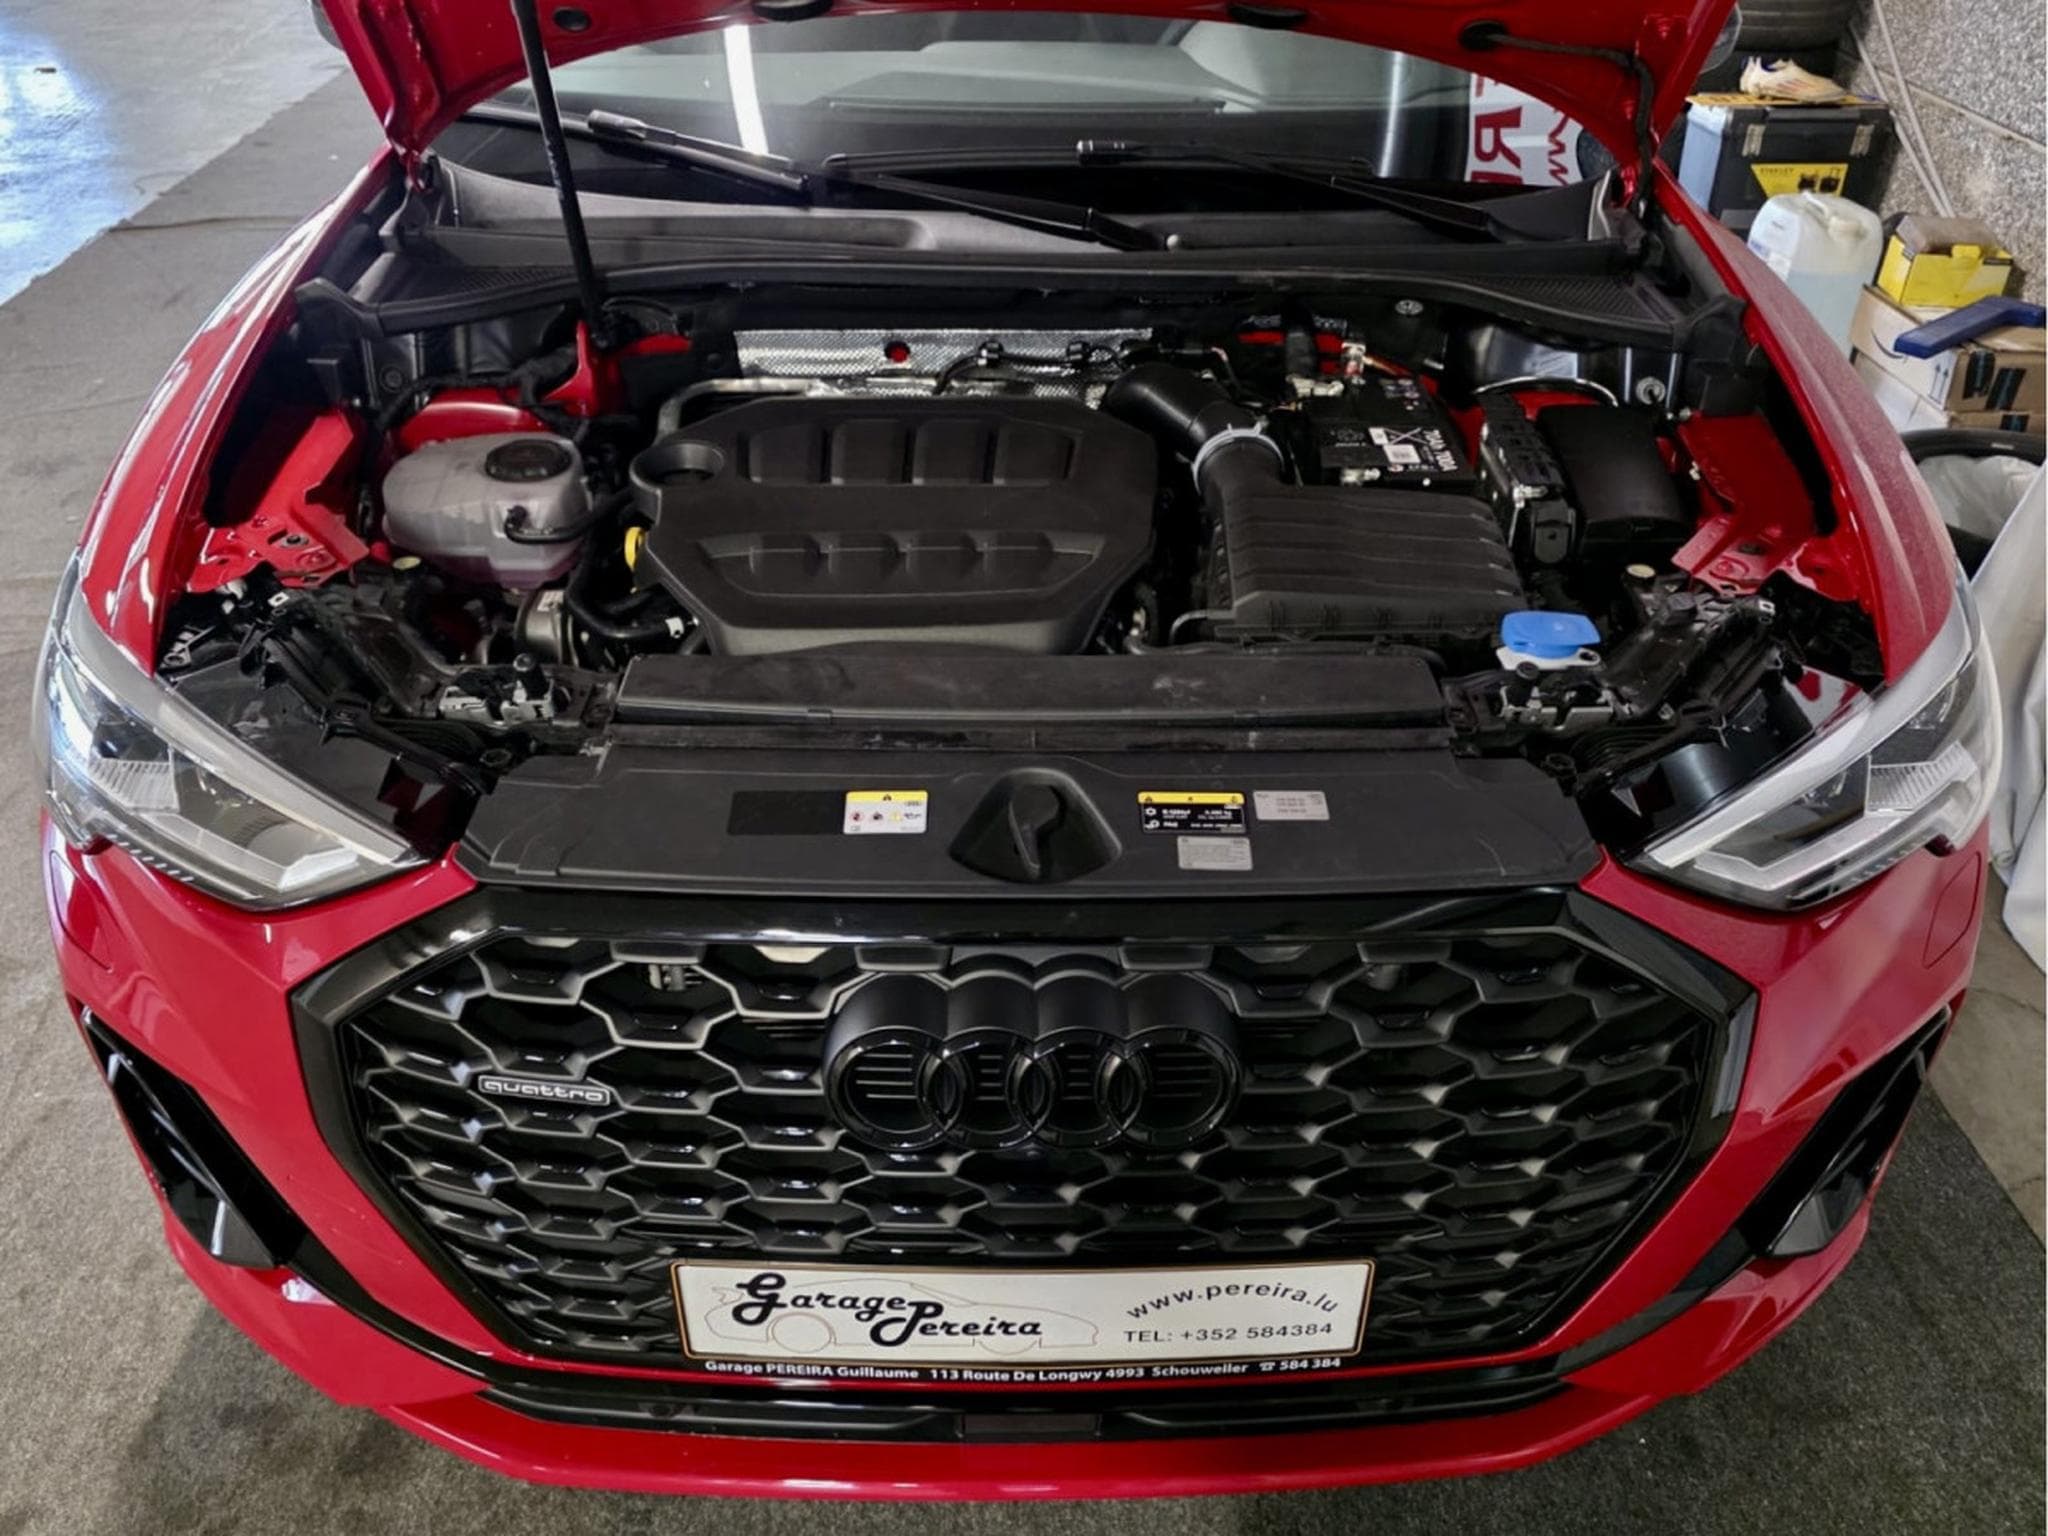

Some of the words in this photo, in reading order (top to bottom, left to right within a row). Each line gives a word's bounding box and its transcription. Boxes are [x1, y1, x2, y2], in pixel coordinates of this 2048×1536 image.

[484, 1081, 604, 1101] quattro
[732, 1272, 909, 1326] Garage
[869, 1299, 1042, 1347] Pereira
[1127, 1282, 1339, 1320] www.pereira.lu
[1123, 1329, 1172, 1343] TEL:
[1180, 1327, 1238, 1342] +352
[1247, 1322, 1333, 1339] 584384
[705, 1360, 765, 1375] Garage
[766, 1363, 833, 1376] PEREIRA
[836, 1365, 919, 1379] Guillaume
[930, 1368, 960, 1380] 113
[963, 1369, 1010, 1382] Route
[1013, 1370, 1035, 1382] De
[1039, 1369, 1102, 1383] Longwy
[1105, 1367, 1145, 1379] 4993
[1151, 1363, 1249, 1377] Schouweiler
[1279, 1359, 1309, 1371] 584
[1311, 1357, 1341, 1370] 384
